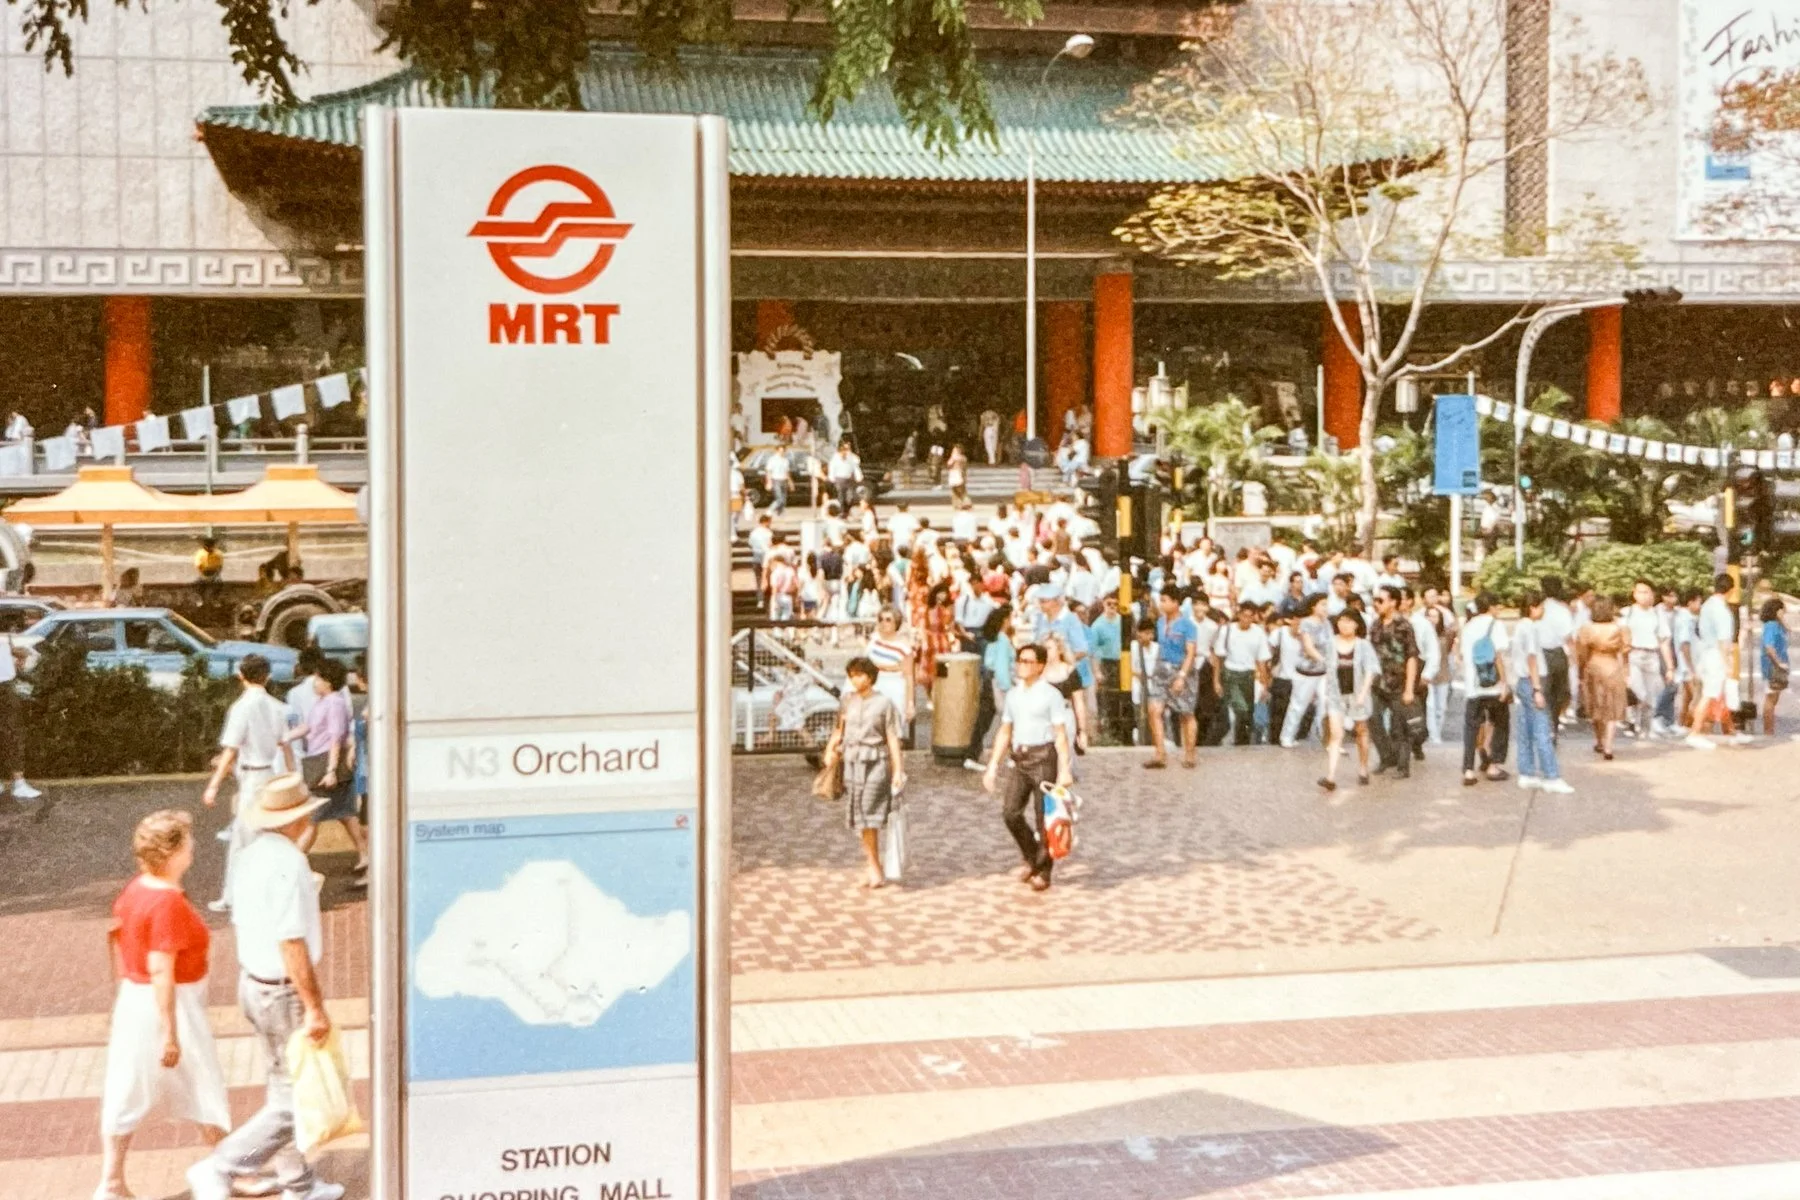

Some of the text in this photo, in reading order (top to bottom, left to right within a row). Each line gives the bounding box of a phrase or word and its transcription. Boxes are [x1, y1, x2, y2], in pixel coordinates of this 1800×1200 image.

[489, 303, 620, 344] MRT
[448, 740, 660, 779] N3 Orchard
[415, 823, 505, 840] System map
[501, 1141, 611, 1171] STATION
[439, 1177, 672, 1200] PING MALL
